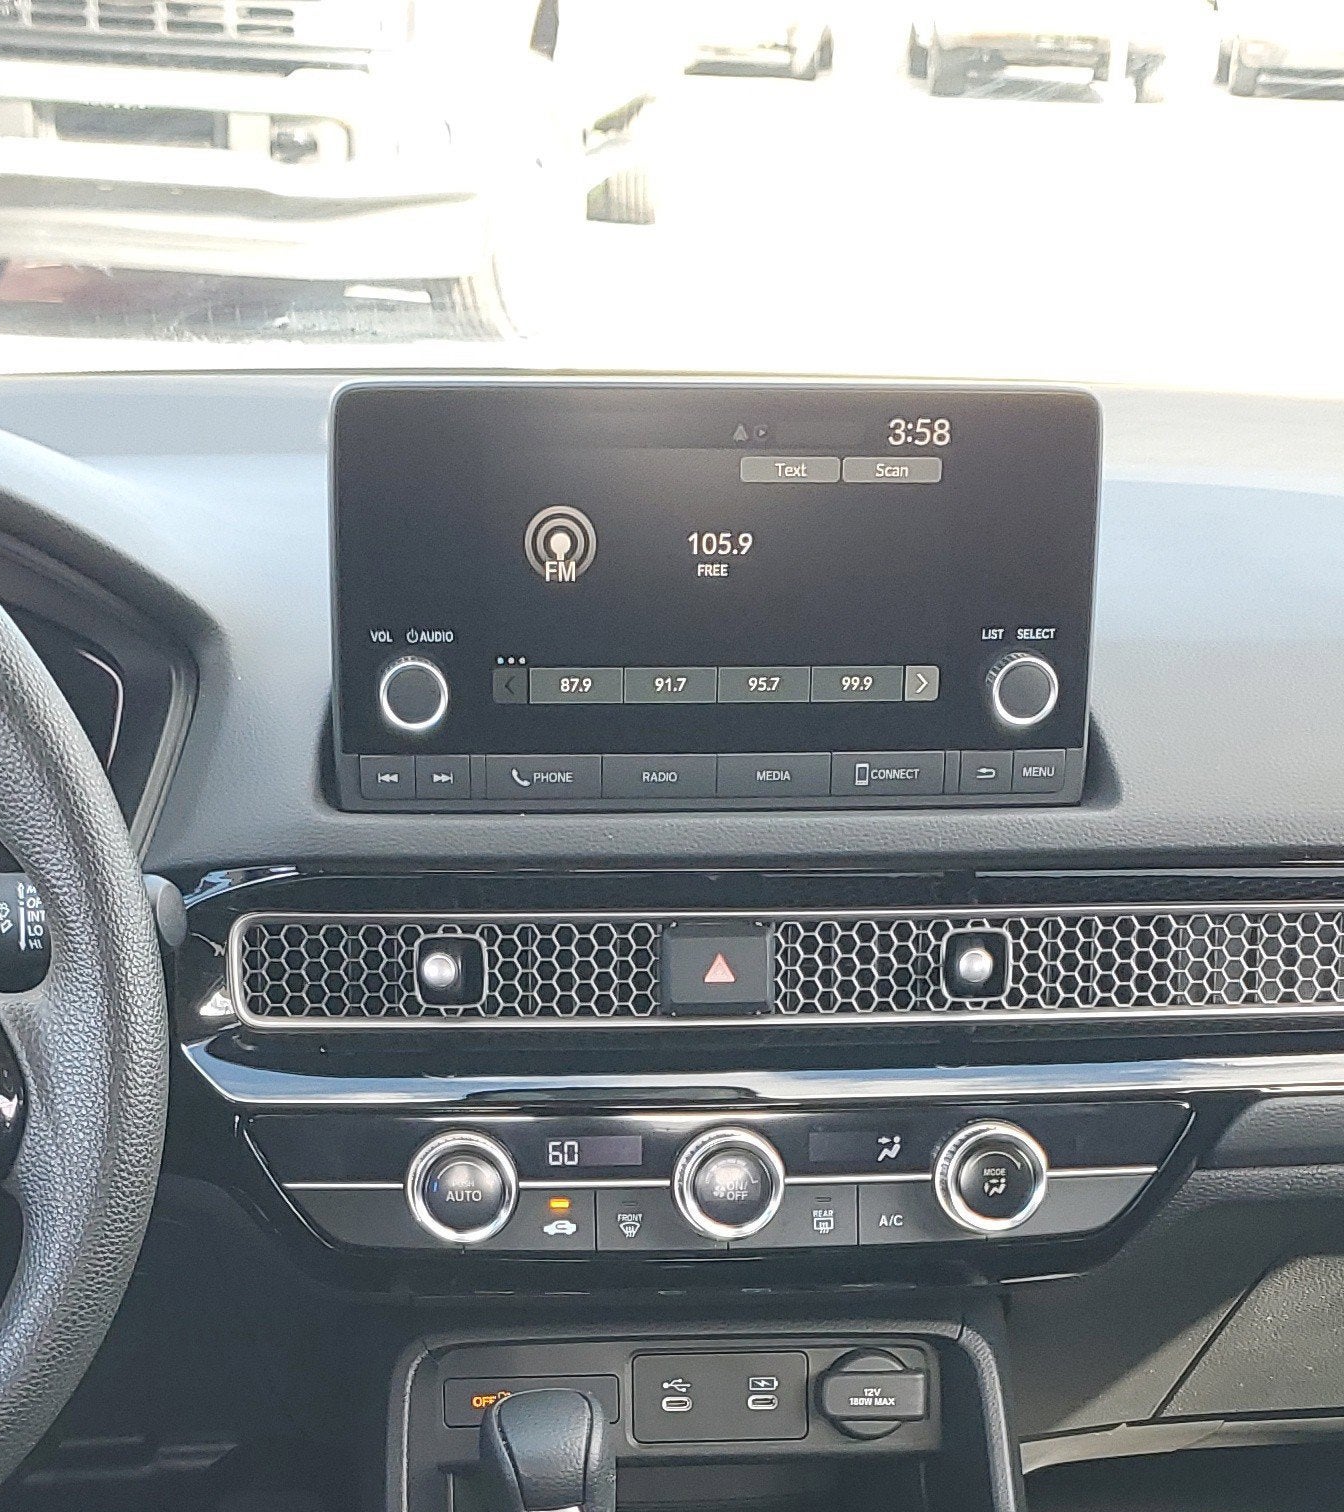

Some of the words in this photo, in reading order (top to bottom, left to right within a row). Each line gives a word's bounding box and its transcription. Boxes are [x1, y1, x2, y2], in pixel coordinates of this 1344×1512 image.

[887, 418, 952, 446] 3:58
[775, 463, 808, 477] Text
[875, 463, 909, 478] Scan
[687, 532, 754, 556] 105.9
[544, 561, 577, 583] FM
[696, 563, 729, 577] FREE
[370, 629, 393, 643] VOL
[419, 629, 454, 643] AUDIO
[981, 628, 1004, 641] LIST
[1016, 628, 1056, 641] SELECT
[560, 678, 592, 692] 87.9
[654, 677, 687, 693] 91.7
[747, 676, 780, 692] 95.7
[841, 676, 873, 692] 99.9
[533, 770, 574, 784] PHONE
[642, 770, 677, 784] RADIO
[756, 769, 791, 783] MEDIA
[870, 767, 920, 781] CONNECT
[1022, 765, 1055, 779] MENU
[27, 909, 46, 923] INT
[27, 924, 44, 937] LO
[548, 1141, 579, 1166] 60
[983, 1168, 1007, 1177] MODE
[446, 1190, 482, 1202] AUTO
[726, 1191, 749, 1200] OFF
[618, 1213, 643, 1222] FRONT
[879, 1214, 903, 1227] A/C
[863, 1388, 882, 1397] 12V
[874, 1397, 896, 1406] MAX
